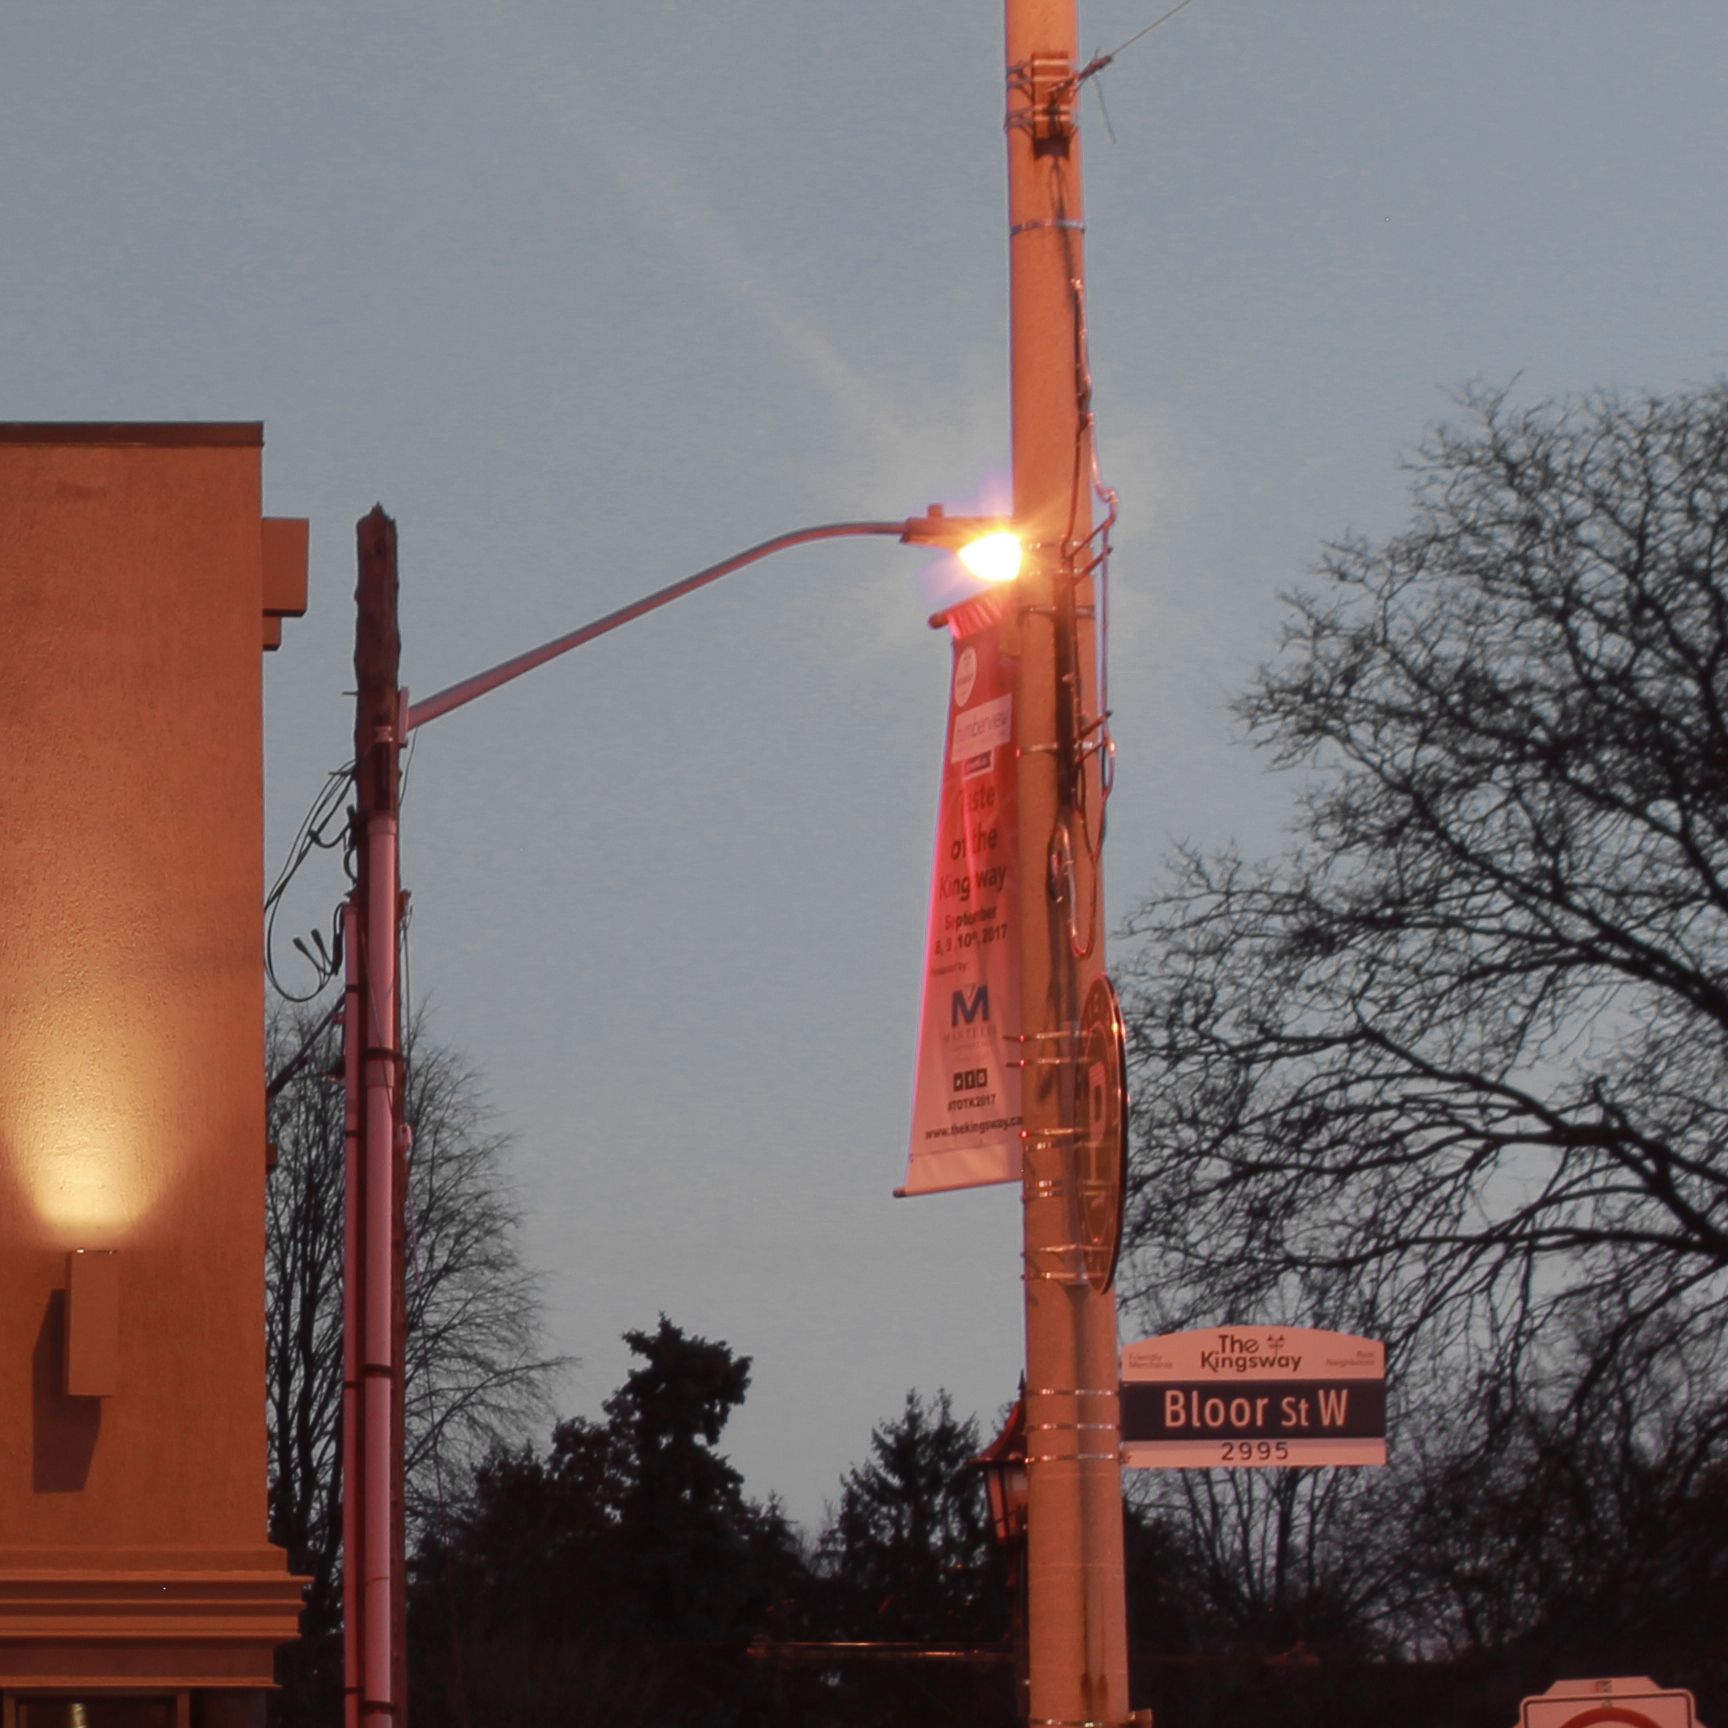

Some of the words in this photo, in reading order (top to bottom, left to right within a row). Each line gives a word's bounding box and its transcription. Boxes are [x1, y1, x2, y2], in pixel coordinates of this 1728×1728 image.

[939, 863, 1007, 902] Kingway
[951, 984, 991, 1028] M
[925, 1115, 1024, 1140] www.thekingsway.ca
[1218, 1334, 1259, 1354] The
[1200, 1351, 1303, 1373] Kingsway
[1164, 1389, 1269, 1428] Bloor
[1281, 1396, 1310, 1427] St
[1318, 1388, 1348, 1427] W
[1221, 1441, 1290, 1462] 2995
